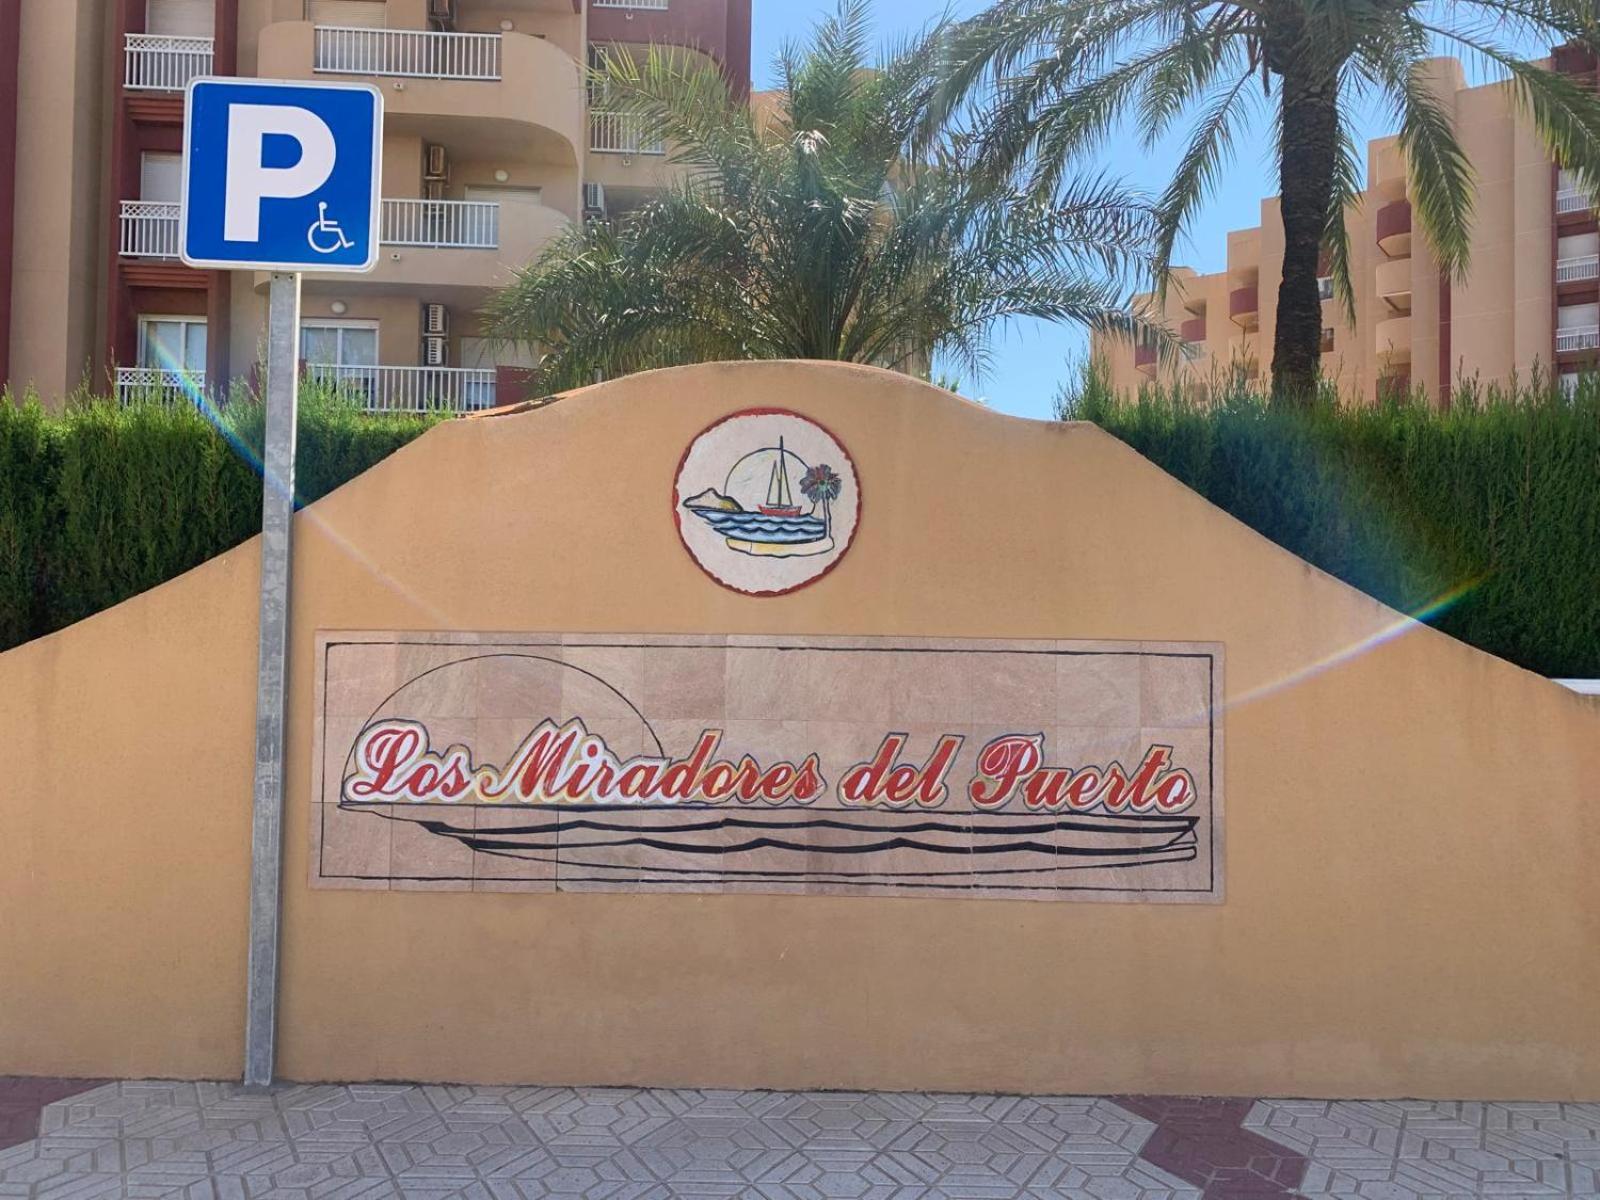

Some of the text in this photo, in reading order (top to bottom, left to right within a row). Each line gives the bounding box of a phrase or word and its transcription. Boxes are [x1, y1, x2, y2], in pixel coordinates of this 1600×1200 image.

[224, 103, 337, 243] P
[350, 724, 1195, 810] Los Miradores del Puerto
